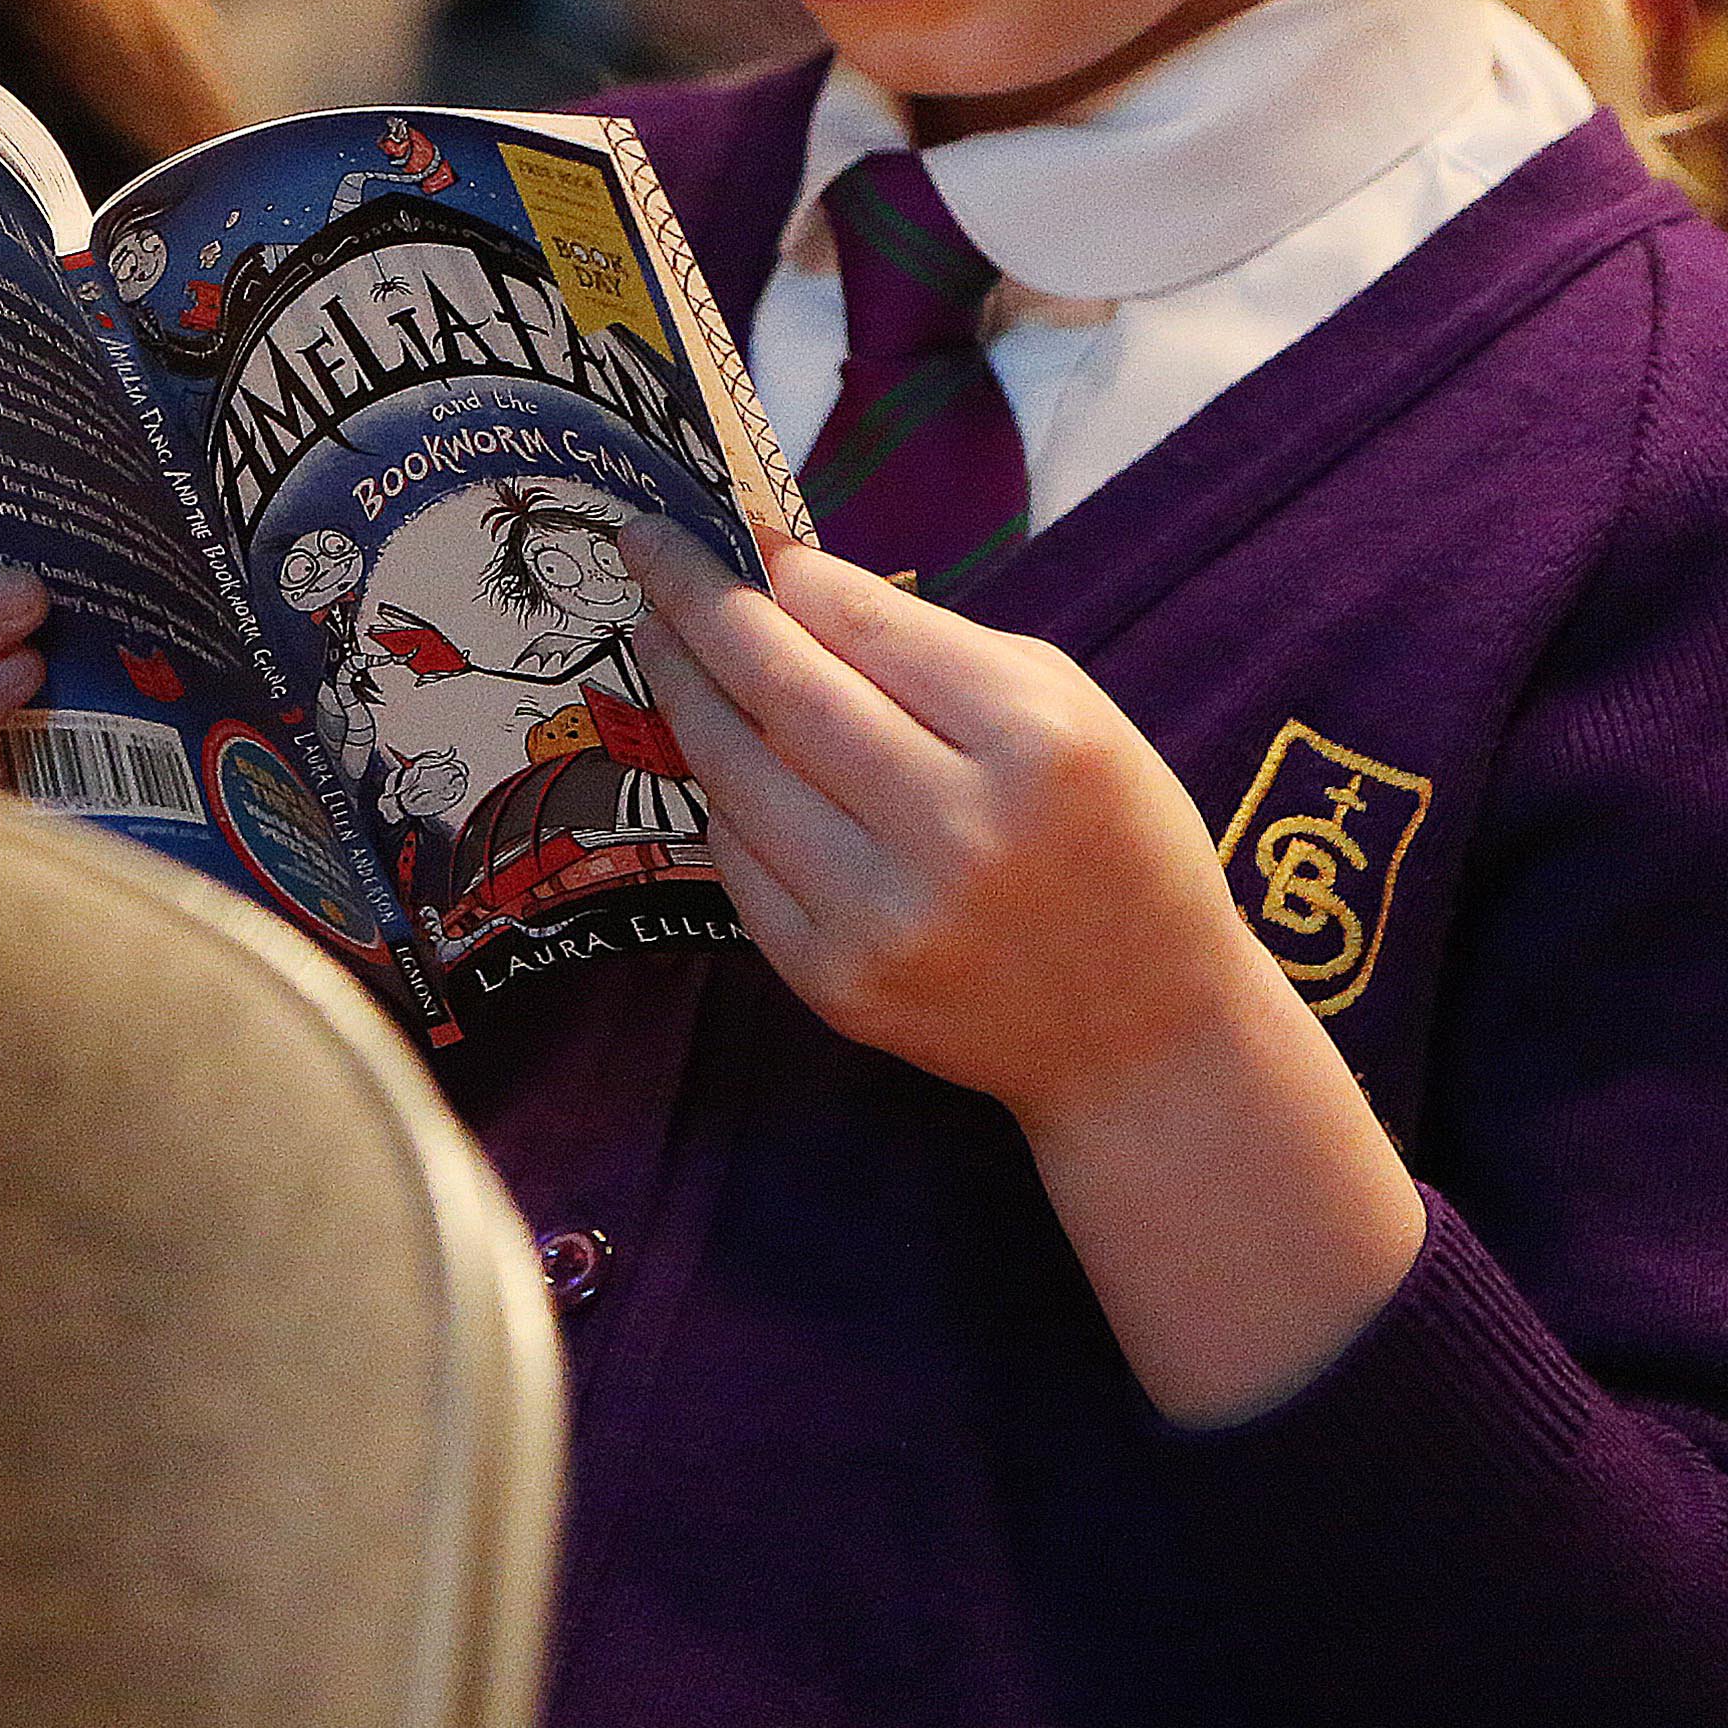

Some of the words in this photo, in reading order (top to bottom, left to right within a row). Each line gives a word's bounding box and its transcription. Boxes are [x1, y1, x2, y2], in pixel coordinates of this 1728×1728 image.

[552, 236, 623, 270] BOOK
[576, 267, 624, 298] DAY
[220, 270, 494, 530] AMELIA
[431, 393, 482, 422] and
[496, 388, 539, 415] the
[352, 424, 562, 523] BOOKWORM
[561, 430, 669, 515] GANG
[96, 335, 148, 406] AMELIA
[139, 407, 173, 464] FANG
[162, 470, 199, 508] AND
[185, 507, 213, 540] THE
[202, 543, 262, 645] BOOKWORM
[252, 648, 298, 700] GANG
[293, 731, 333, 786] LAURA
[320, 788, 359, 843] ELLEN
[348, 846, 399, 924] ANDERSON
[475, 931, 623, 992] LAURA
